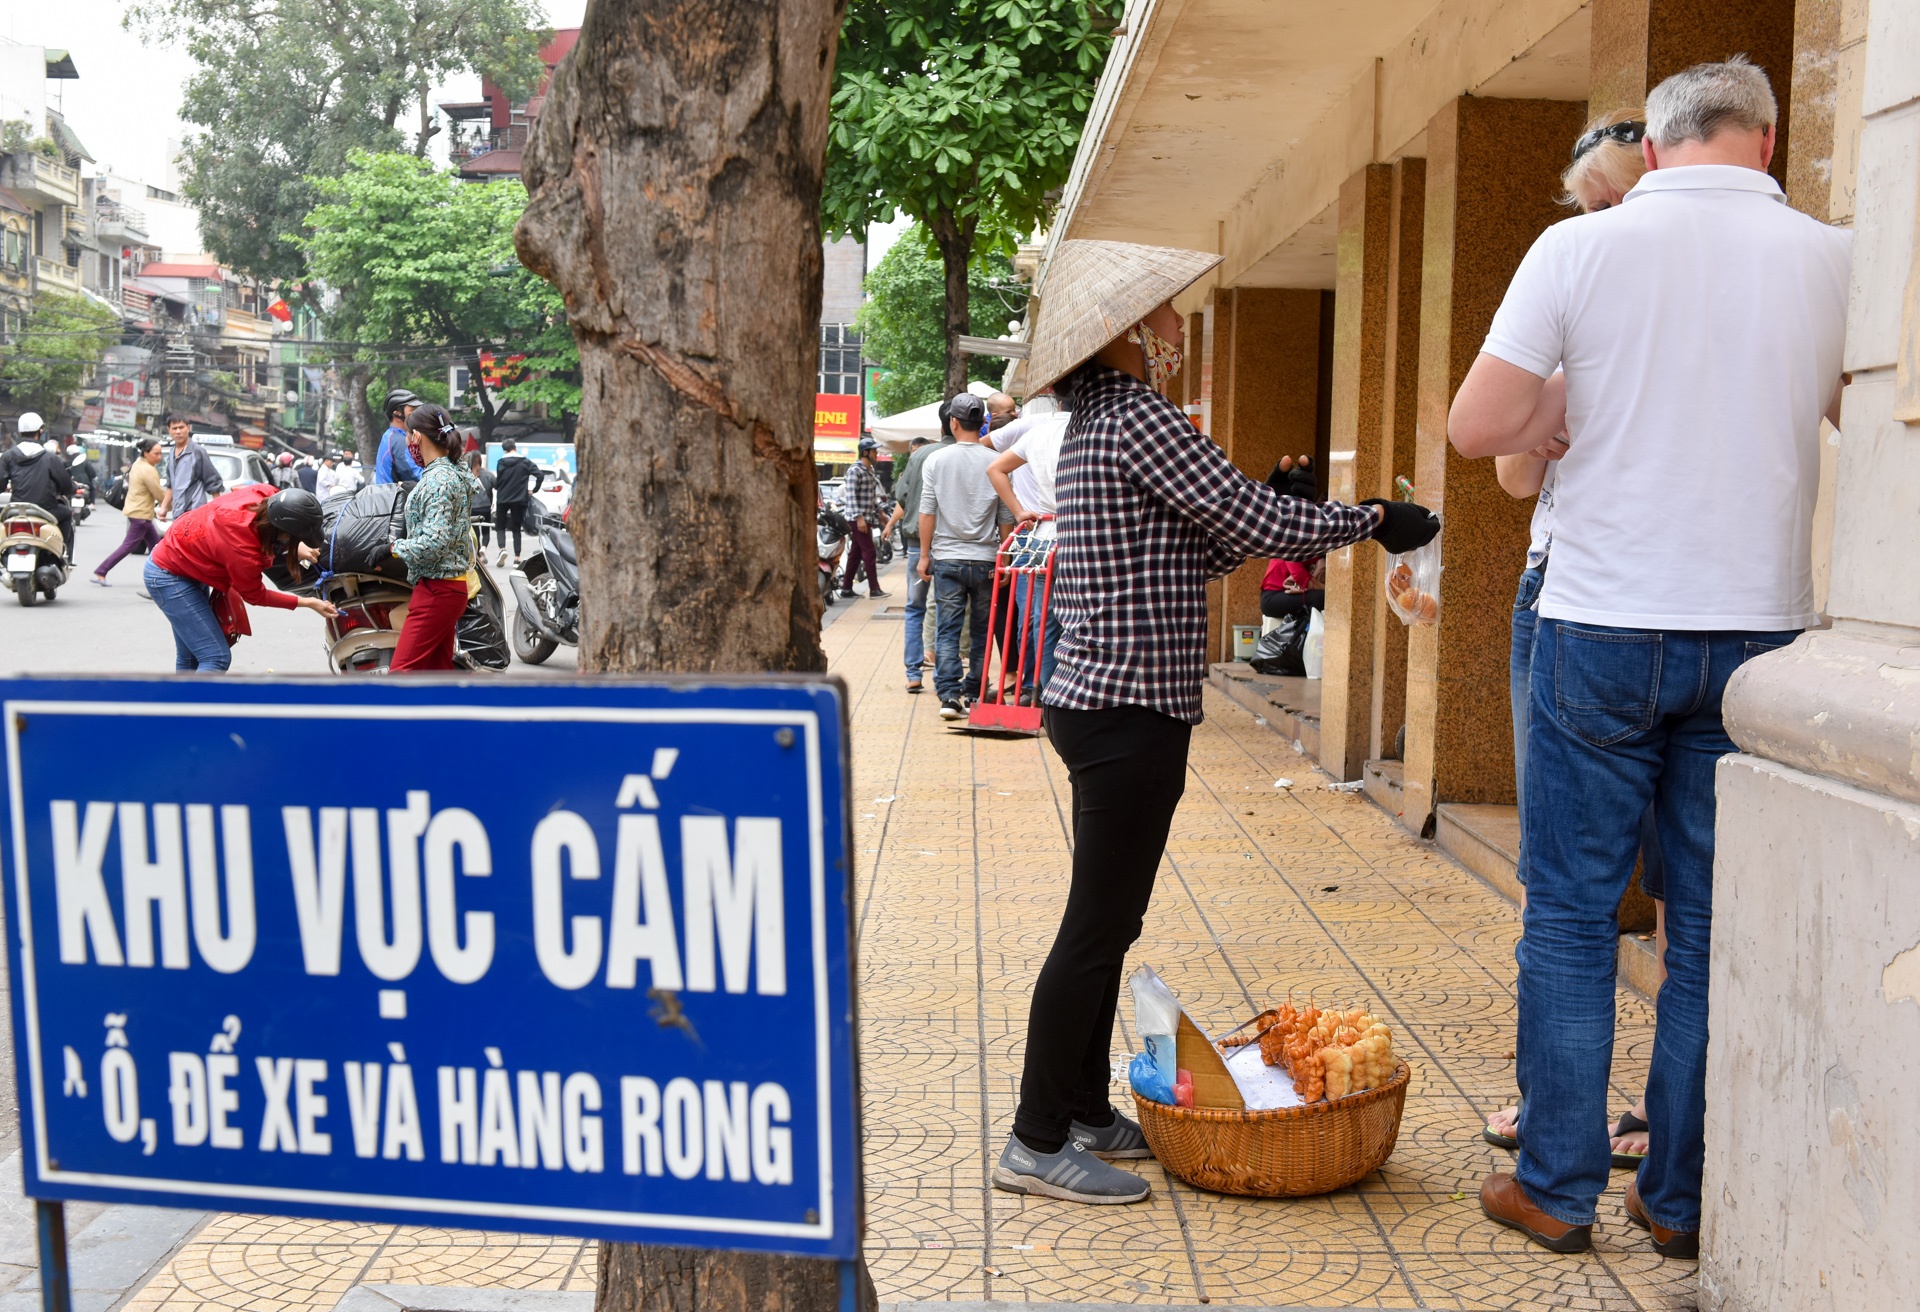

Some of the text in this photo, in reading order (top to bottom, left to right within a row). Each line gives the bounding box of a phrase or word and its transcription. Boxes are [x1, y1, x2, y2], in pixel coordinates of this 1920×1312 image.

[50, 748, 786, 1018] KHU VỰC CẤM
[64, 1014, 792, 1185] Ỗ, ĐỂ XE VÀ HÀNG RONG
